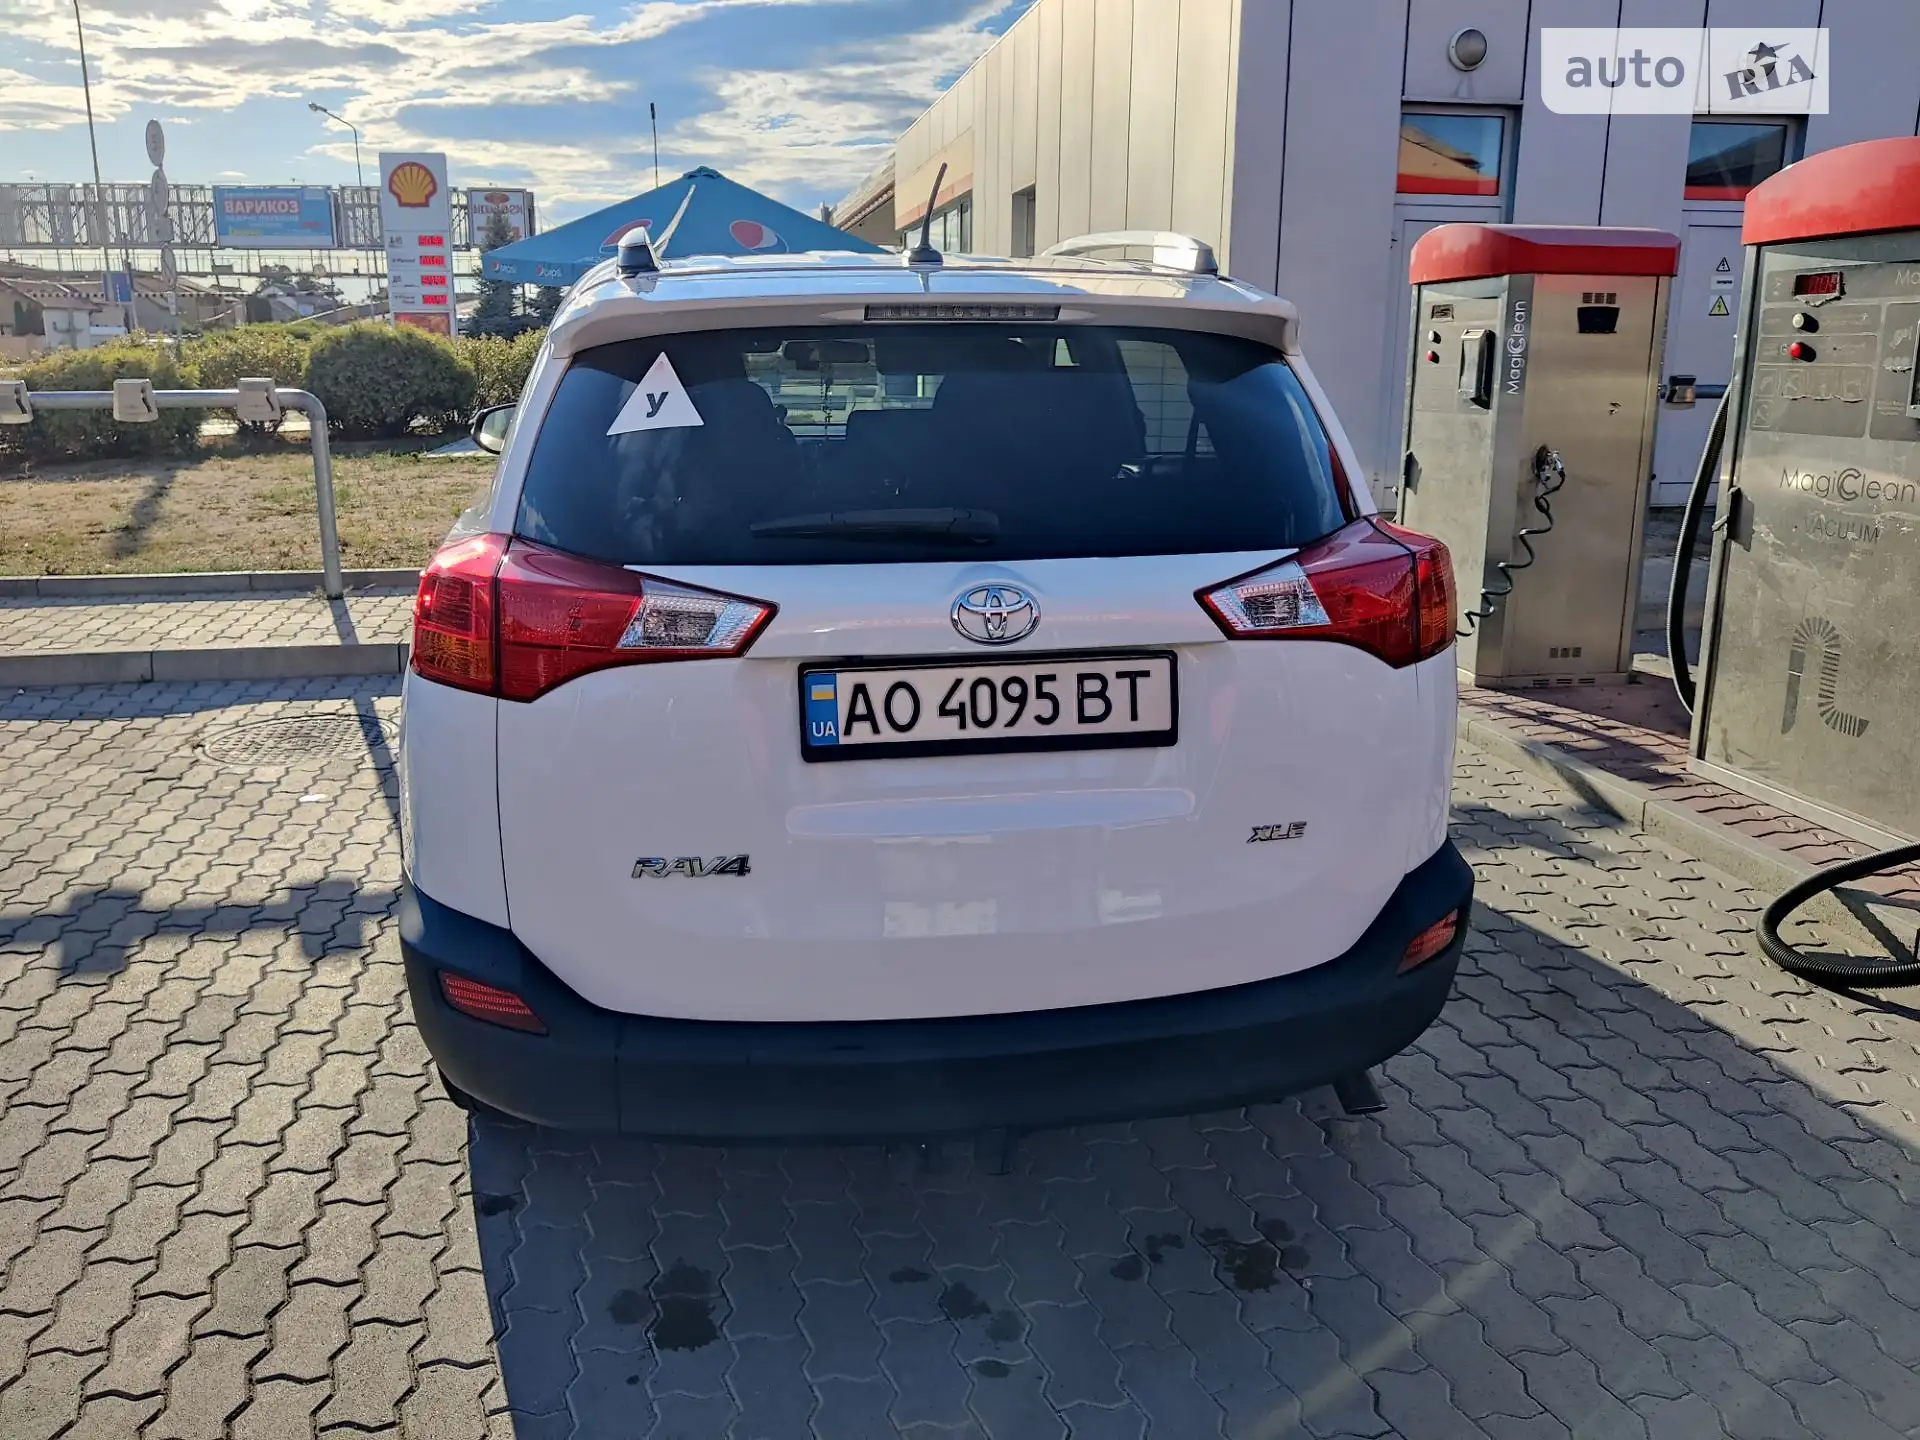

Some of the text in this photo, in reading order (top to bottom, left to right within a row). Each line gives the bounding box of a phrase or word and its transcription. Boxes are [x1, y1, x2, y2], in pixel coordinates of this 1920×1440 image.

[224, 200, 299, 214] ВАРИКОЗ
[1506, 301, 1526, 395] MagiClean
[843, 669, 1151, 736] AO 4095 BT
[812, 720, 837, 737] UA
[1246, 821, 1307, 843] XLE
[631, 854, 750, 878] RAV4
